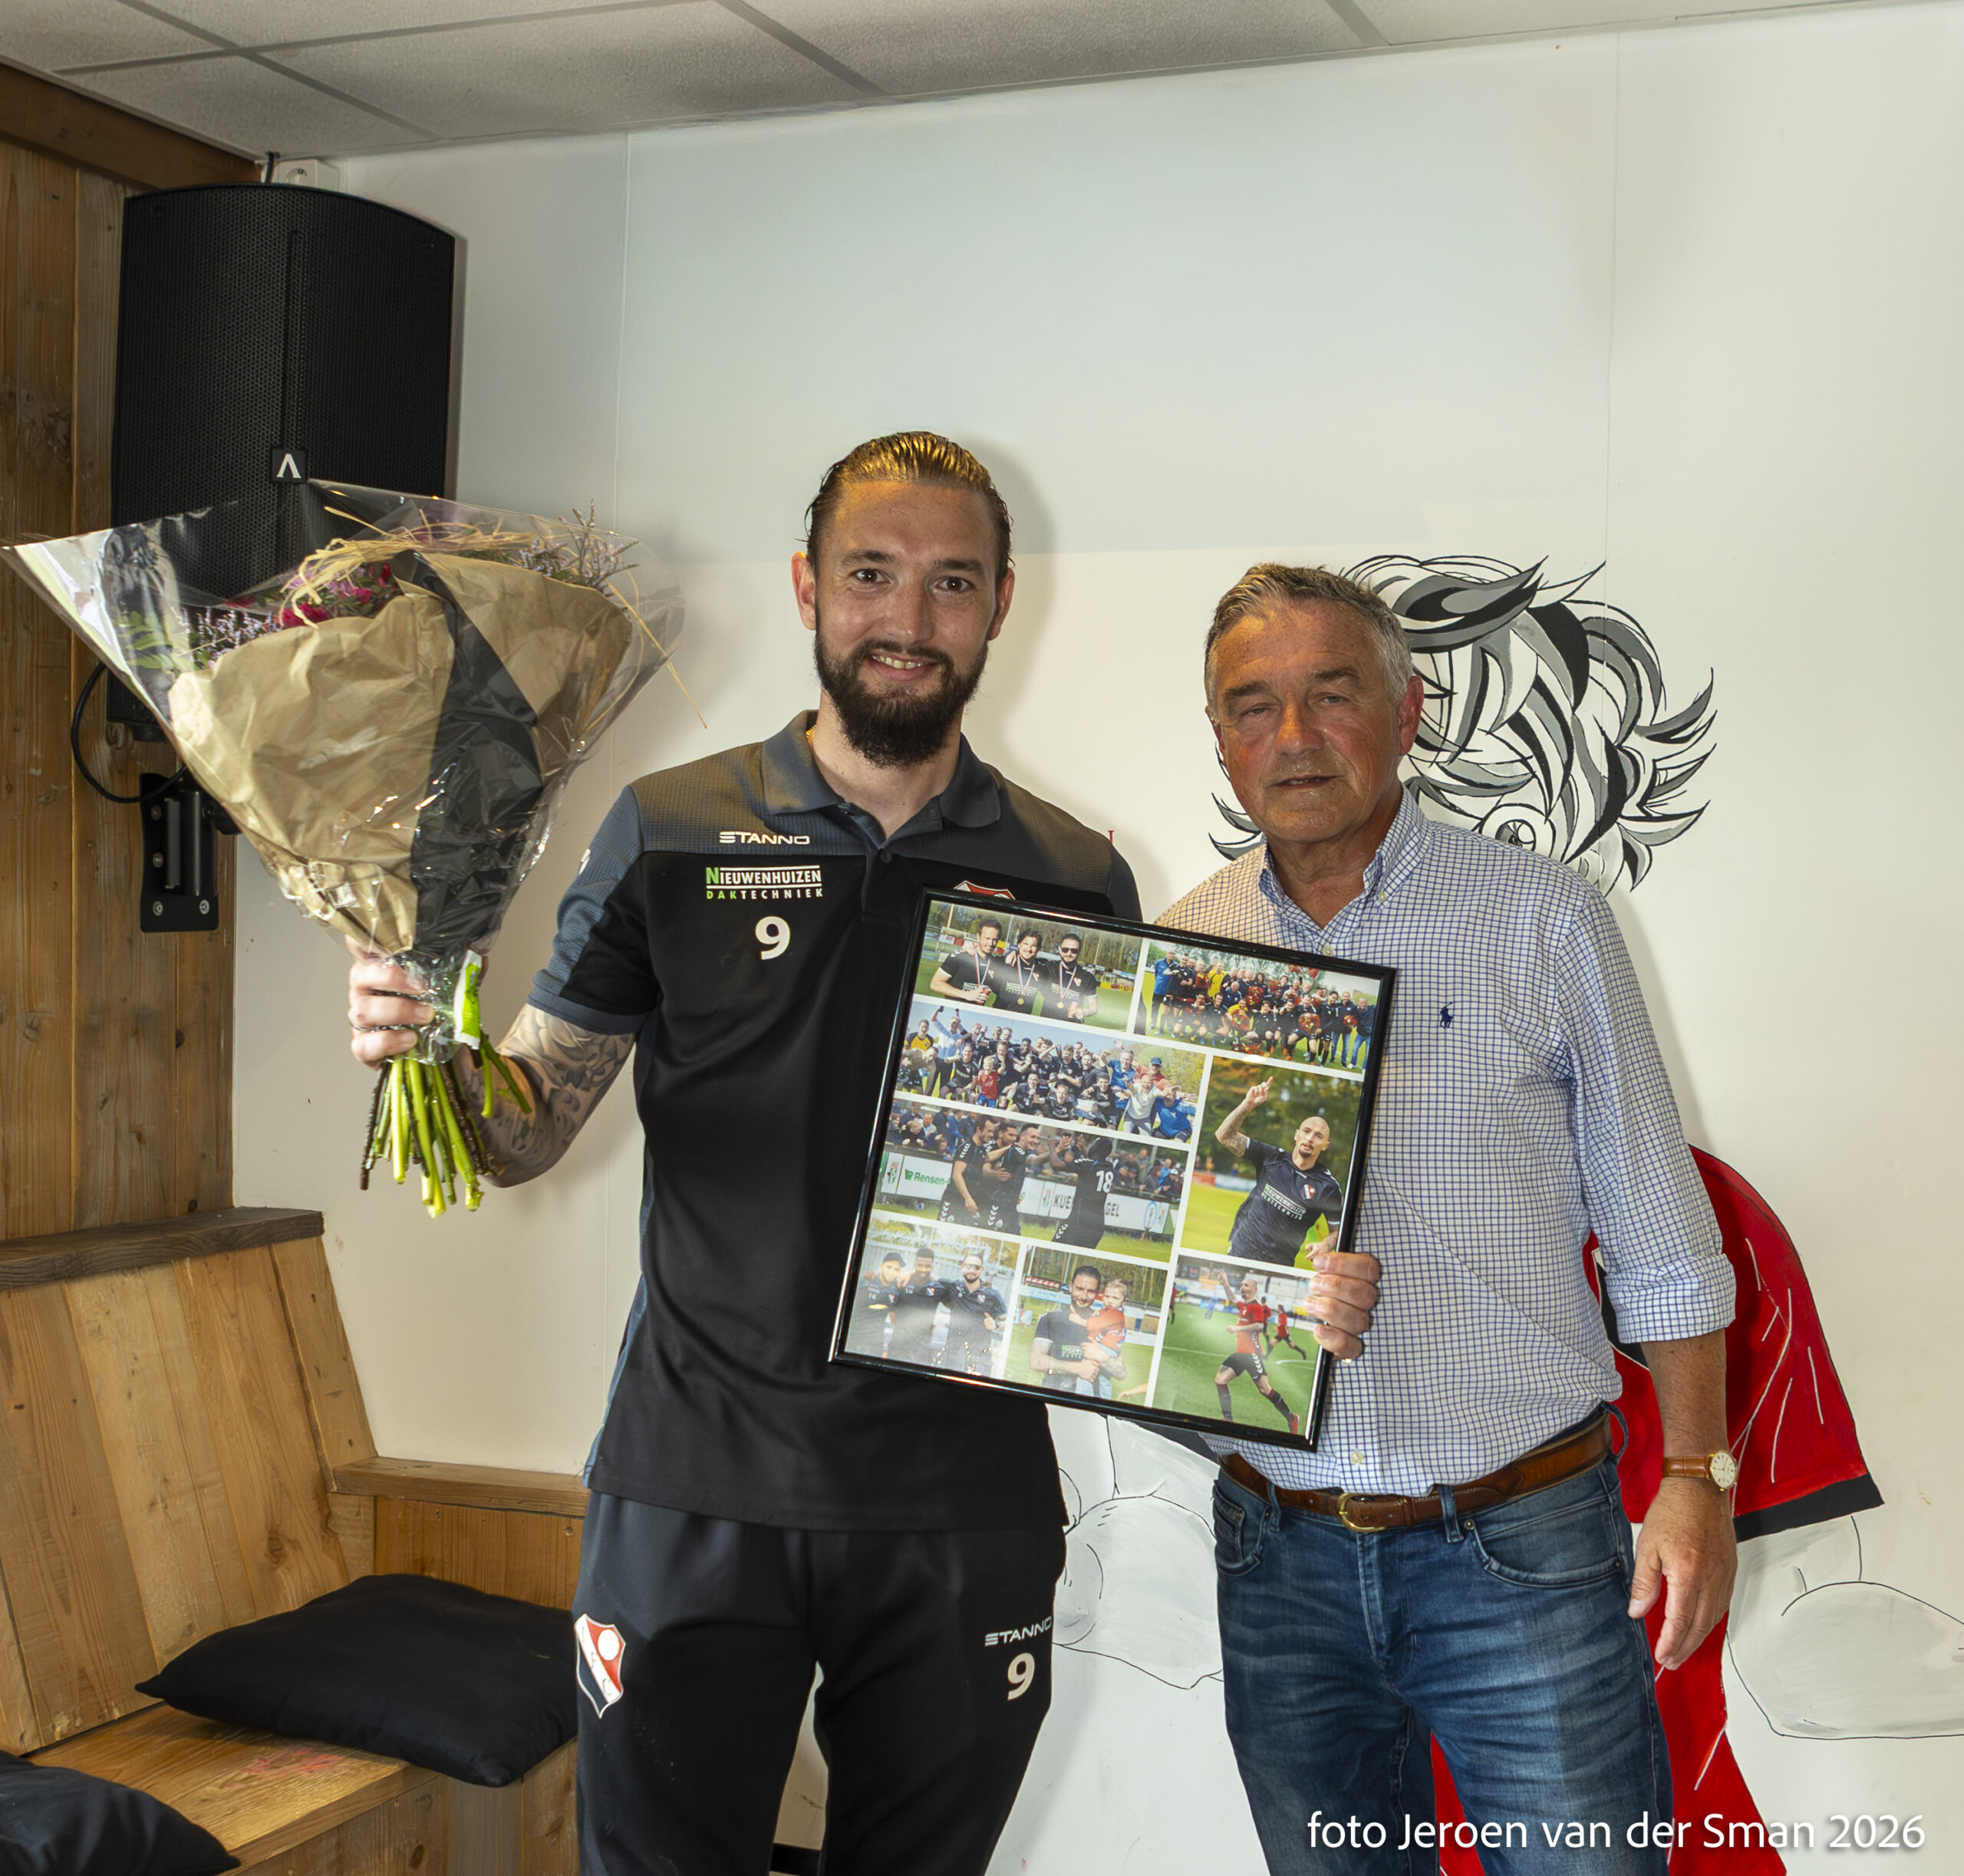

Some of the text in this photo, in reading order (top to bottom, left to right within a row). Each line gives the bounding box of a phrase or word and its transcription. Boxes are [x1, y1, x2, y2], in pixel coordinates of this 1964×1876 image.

[719, 831, 810, 845] STANNO
[705, 867, 822, 885] NIEUWENHUIZEN
[706, 888, 823, 899] DAKTECHNIEK
[754, 915, 791, 961] 9
[1096, 1170, 1114, 1193] 18
[1053, 1193, 1120, 1218] KUE GEL
[984, 1615, 1053, 1647] STANNO
[1007, 1652, 1036, 1701] 9
